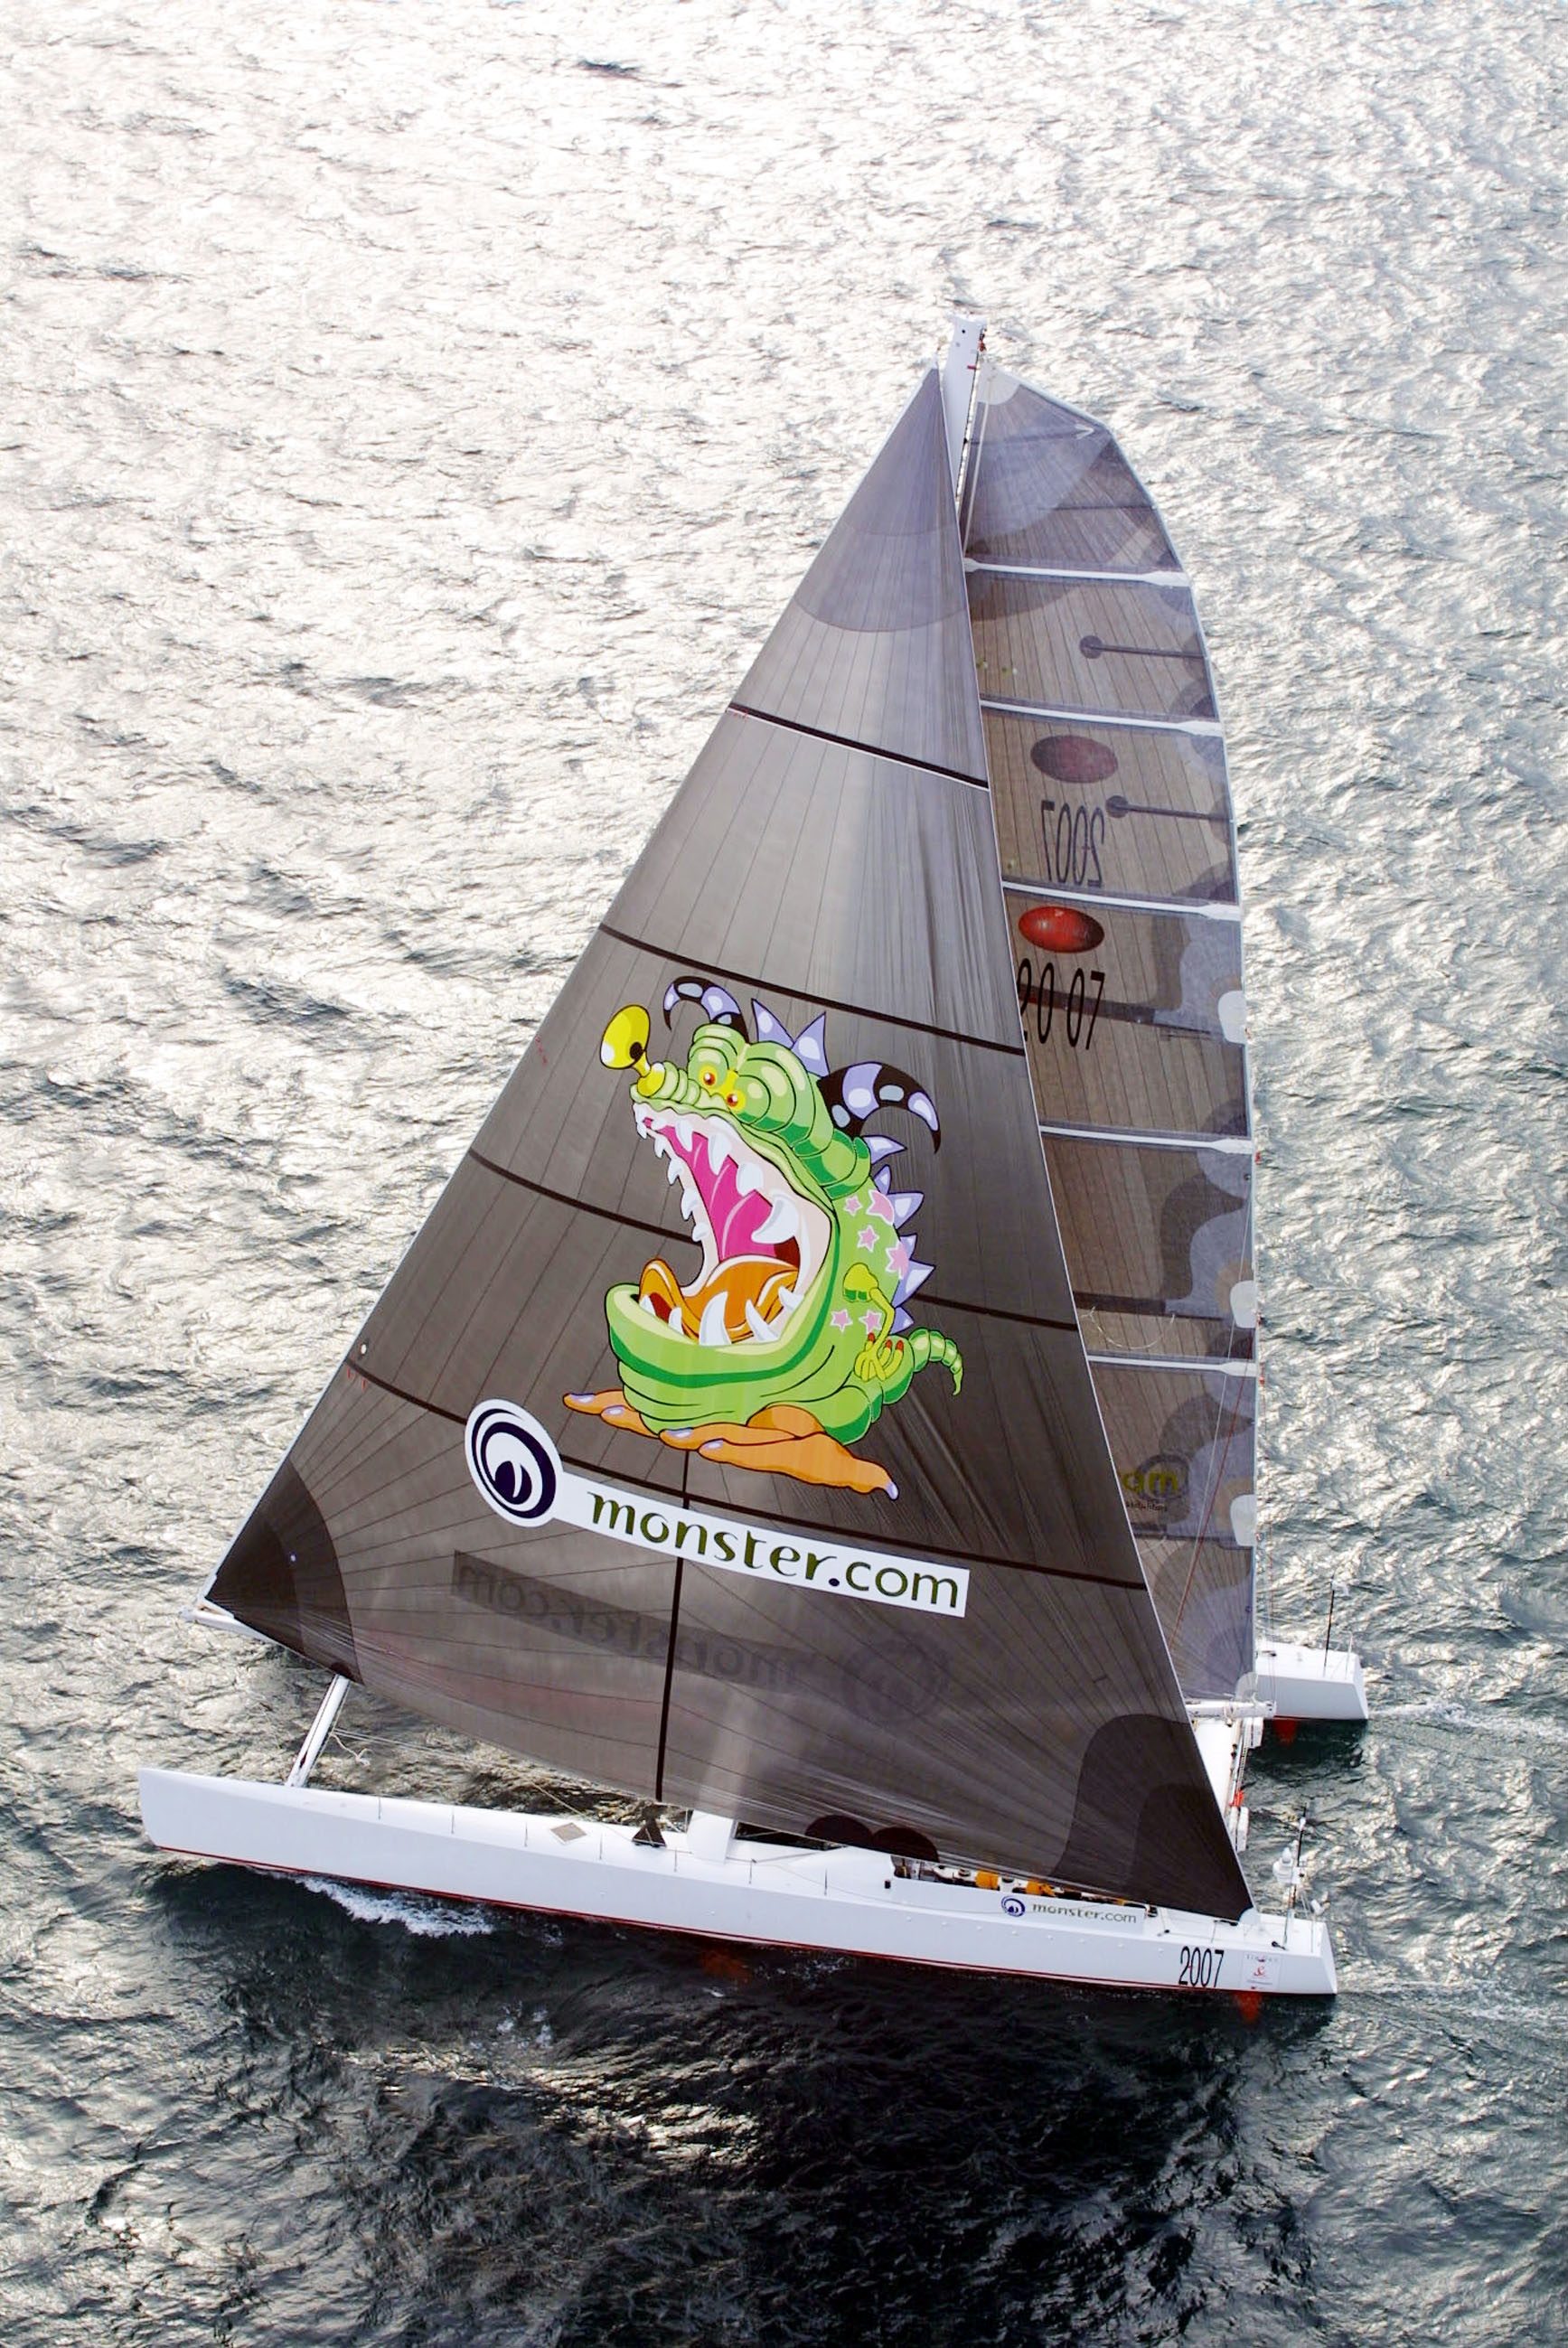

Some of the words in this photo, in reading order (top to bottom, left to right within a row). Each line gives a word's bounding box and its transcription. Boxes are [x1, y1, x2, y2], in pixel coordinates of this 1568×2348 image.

[587, 1490, 959, 1608] monster.com
[1031, 1902, 1138, 1924] monster.com
[1178, 1945, 1225, 1988] 2007
